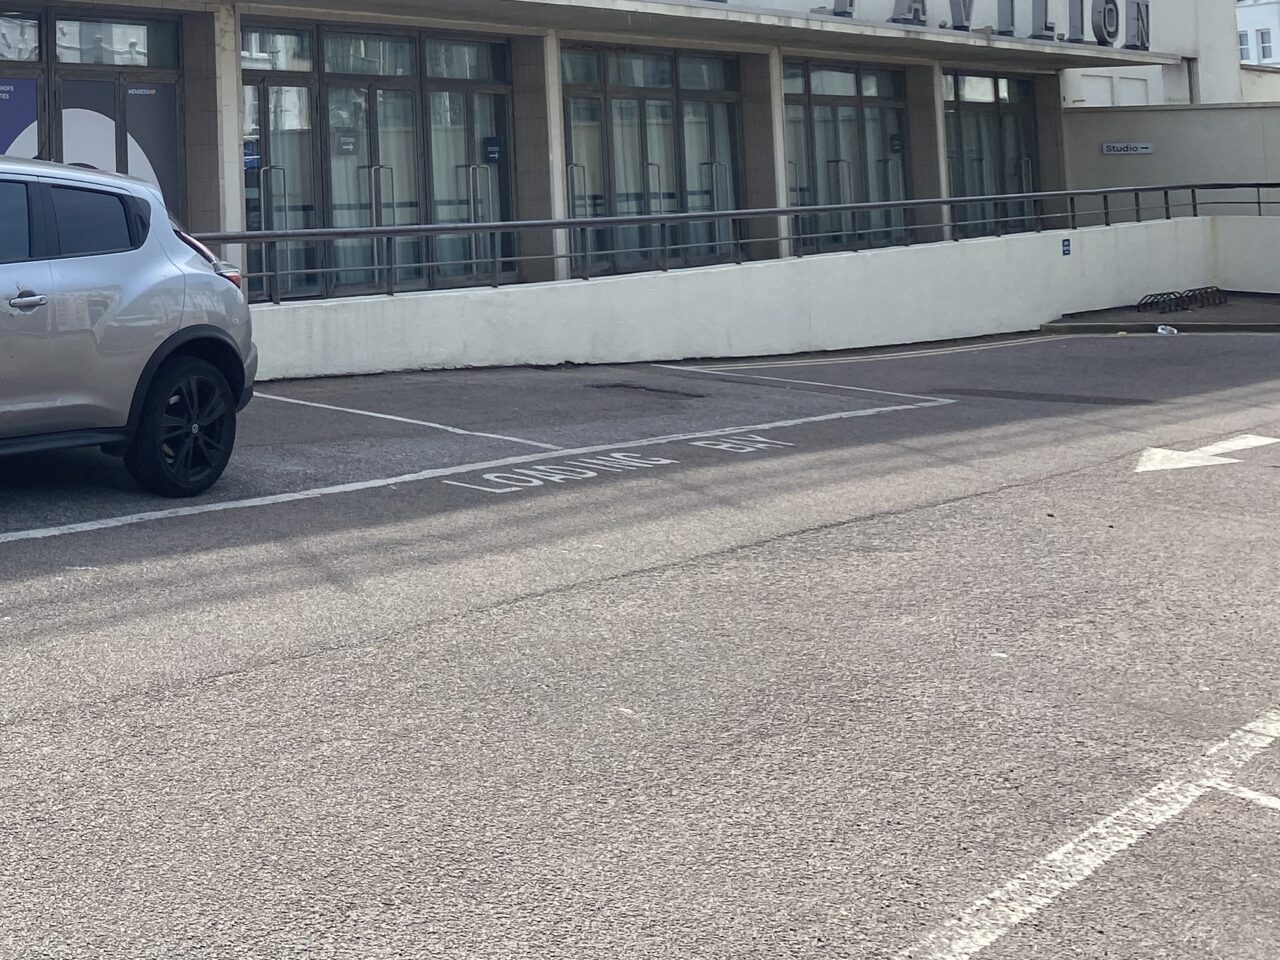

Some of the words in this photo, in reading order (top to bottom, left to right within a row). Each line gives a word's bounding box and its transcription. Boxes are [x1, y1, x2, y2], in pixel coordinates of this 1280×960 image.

[1105, 143, 1139, 153] Studio
[441, 451, 681, 494] LOADING
[688, 433, 795, 454] BAY
